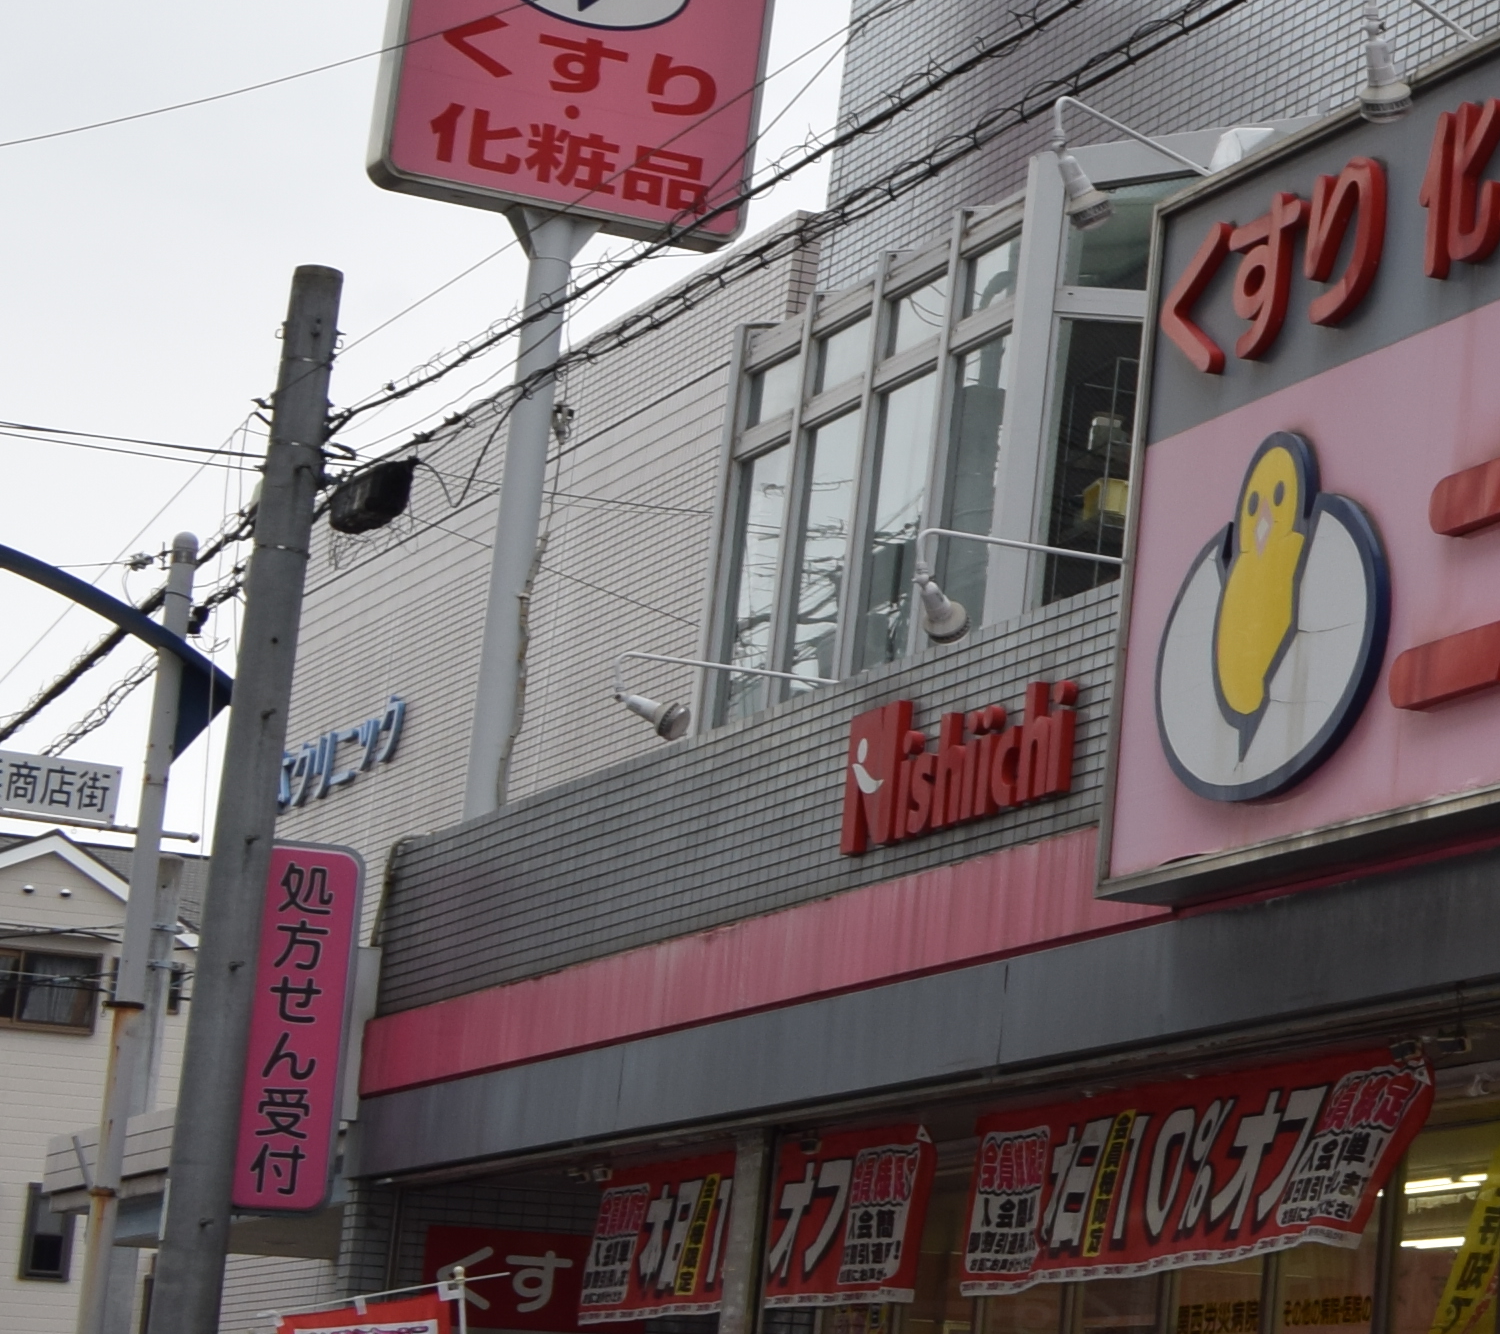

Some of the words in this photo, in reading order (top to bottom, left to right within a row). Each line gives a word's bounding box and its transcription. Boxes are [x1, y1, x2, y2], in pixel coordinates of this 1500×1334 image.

[442, 14, 718, 117] くすり
[429, 102, 710, 216] 化粧品
[1157, 155, 1389, 376] くすり
[0, 756, 110, 812] 商店街
[839, 677, 1080, 856] Nishiichi
[251, 862, 334, 1196] 処方せん受付
